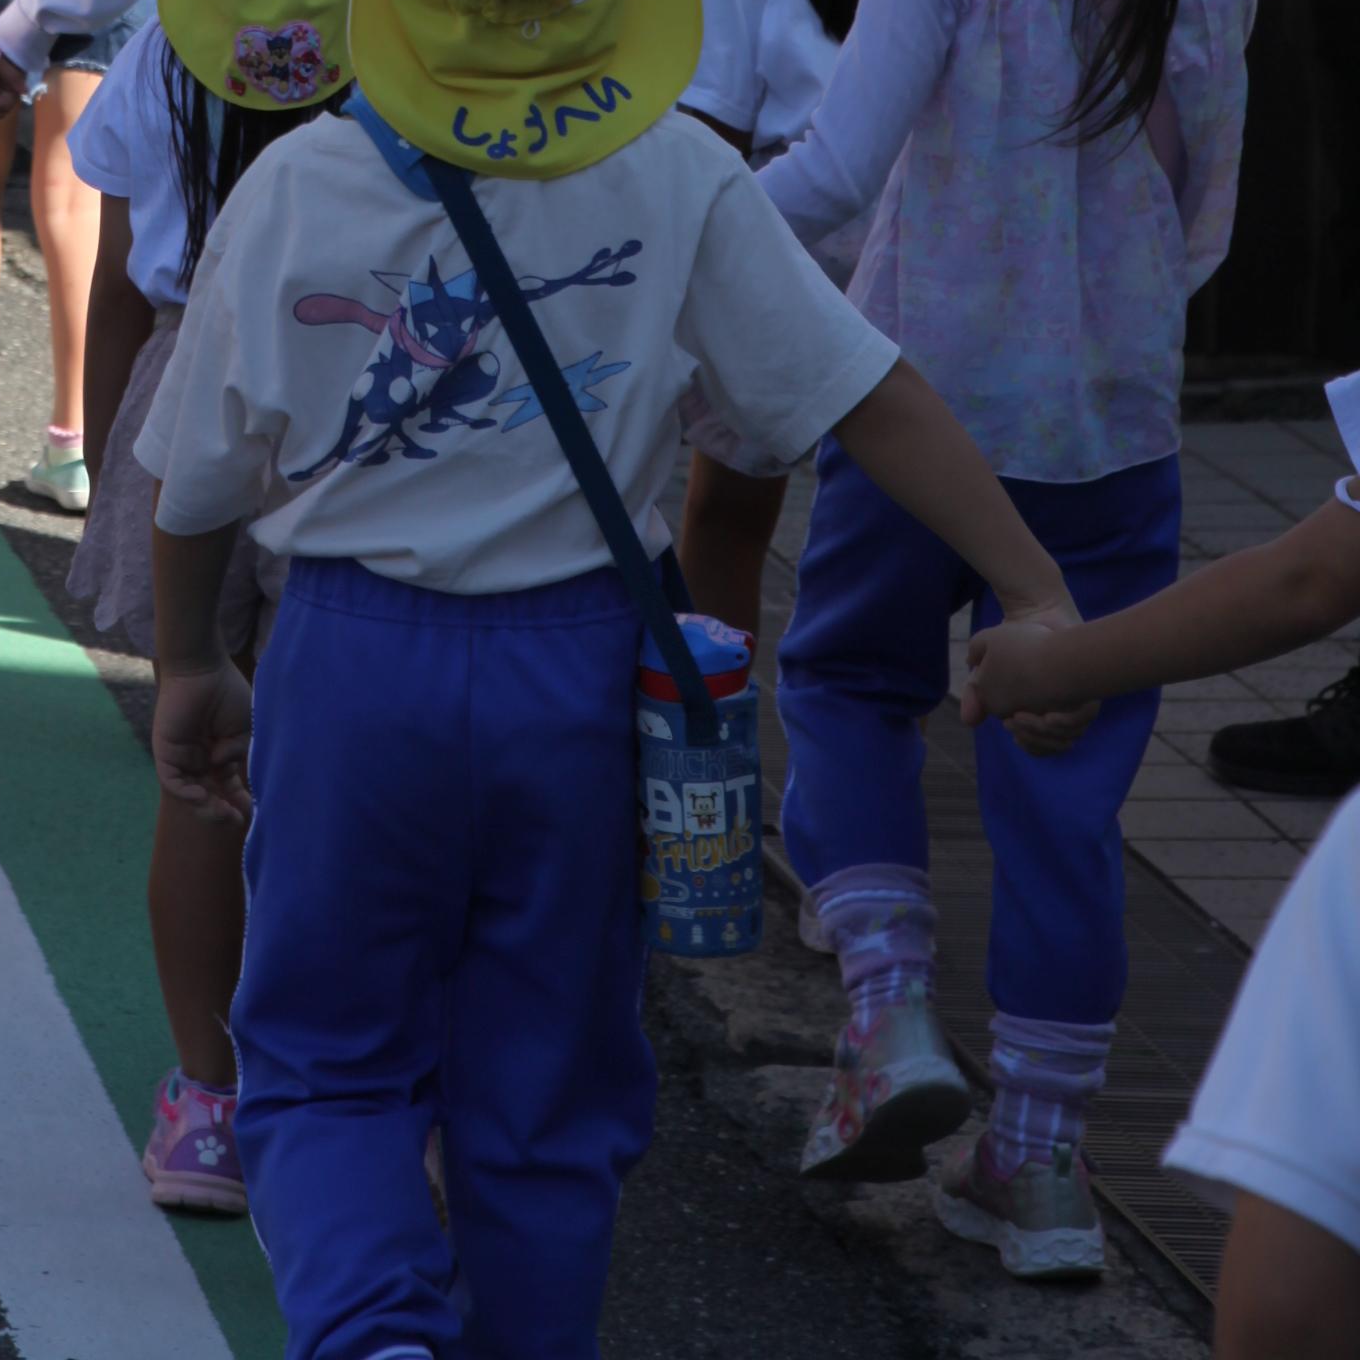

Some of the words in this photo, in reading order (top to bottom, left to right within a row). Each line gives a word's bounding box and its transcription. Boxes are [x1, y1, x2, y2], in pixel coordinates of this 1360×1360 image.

[452, 76, 633, 160] しょうへい
